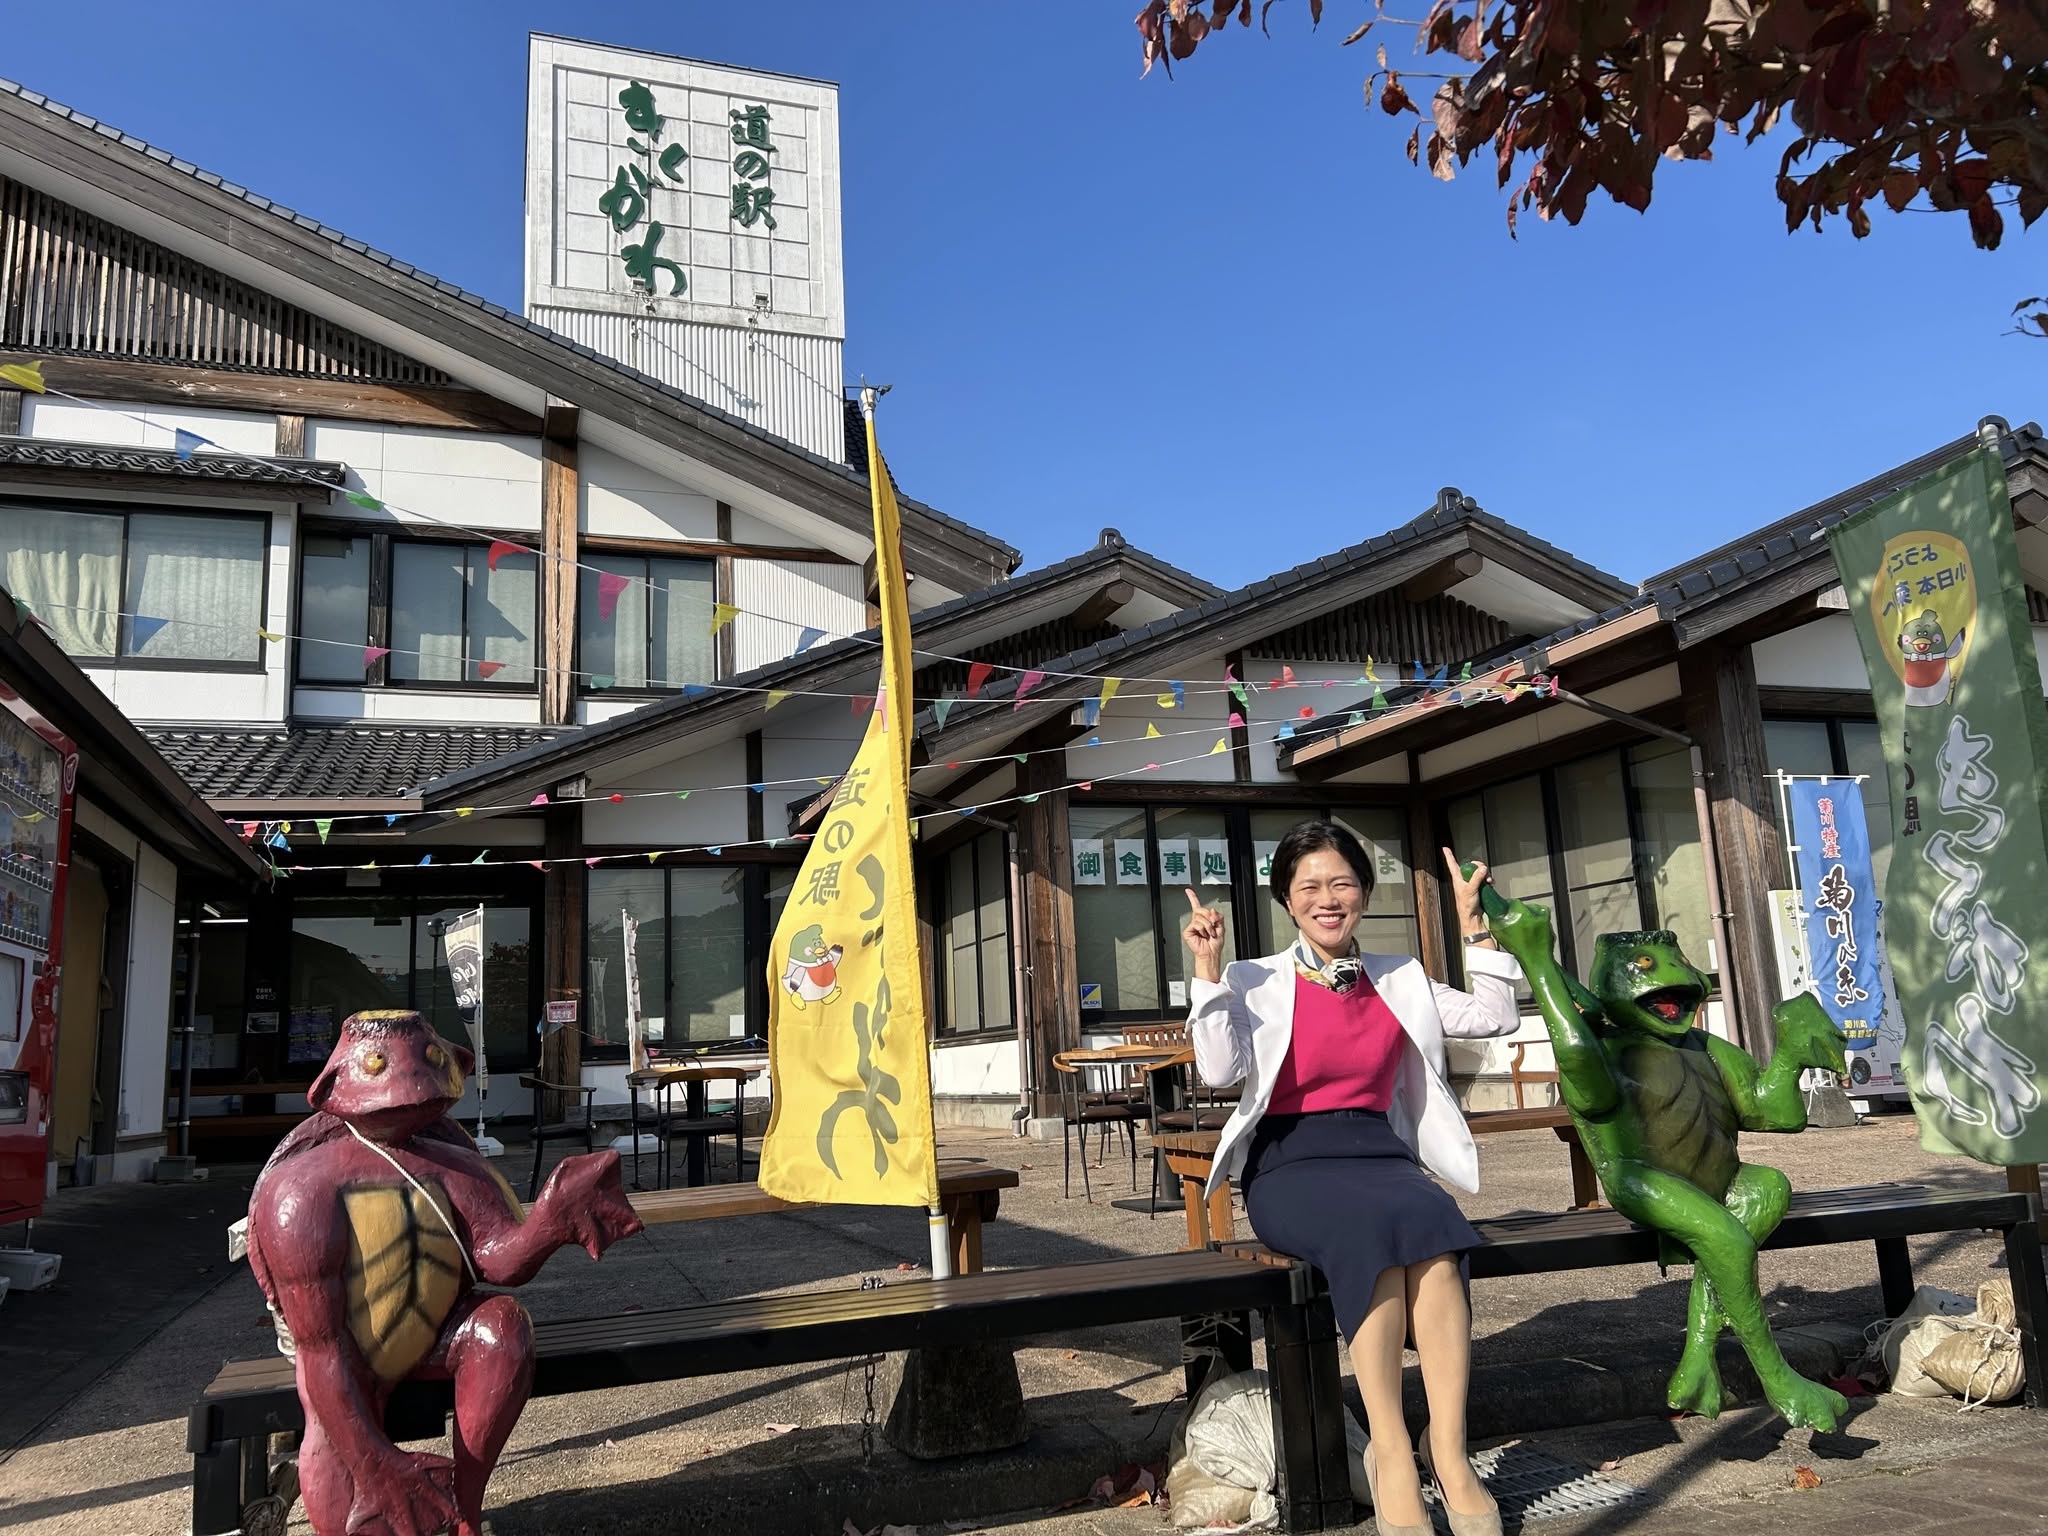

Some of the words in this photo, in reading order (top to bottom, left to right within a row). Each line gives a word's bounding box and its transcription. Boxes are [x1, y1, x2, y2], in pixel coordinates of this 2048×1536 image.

[599, 80, 690, 297] きくがわ
[728, 104, 778, 230] 道の駅
[1077, 852, 1227, 877] 御食事処
